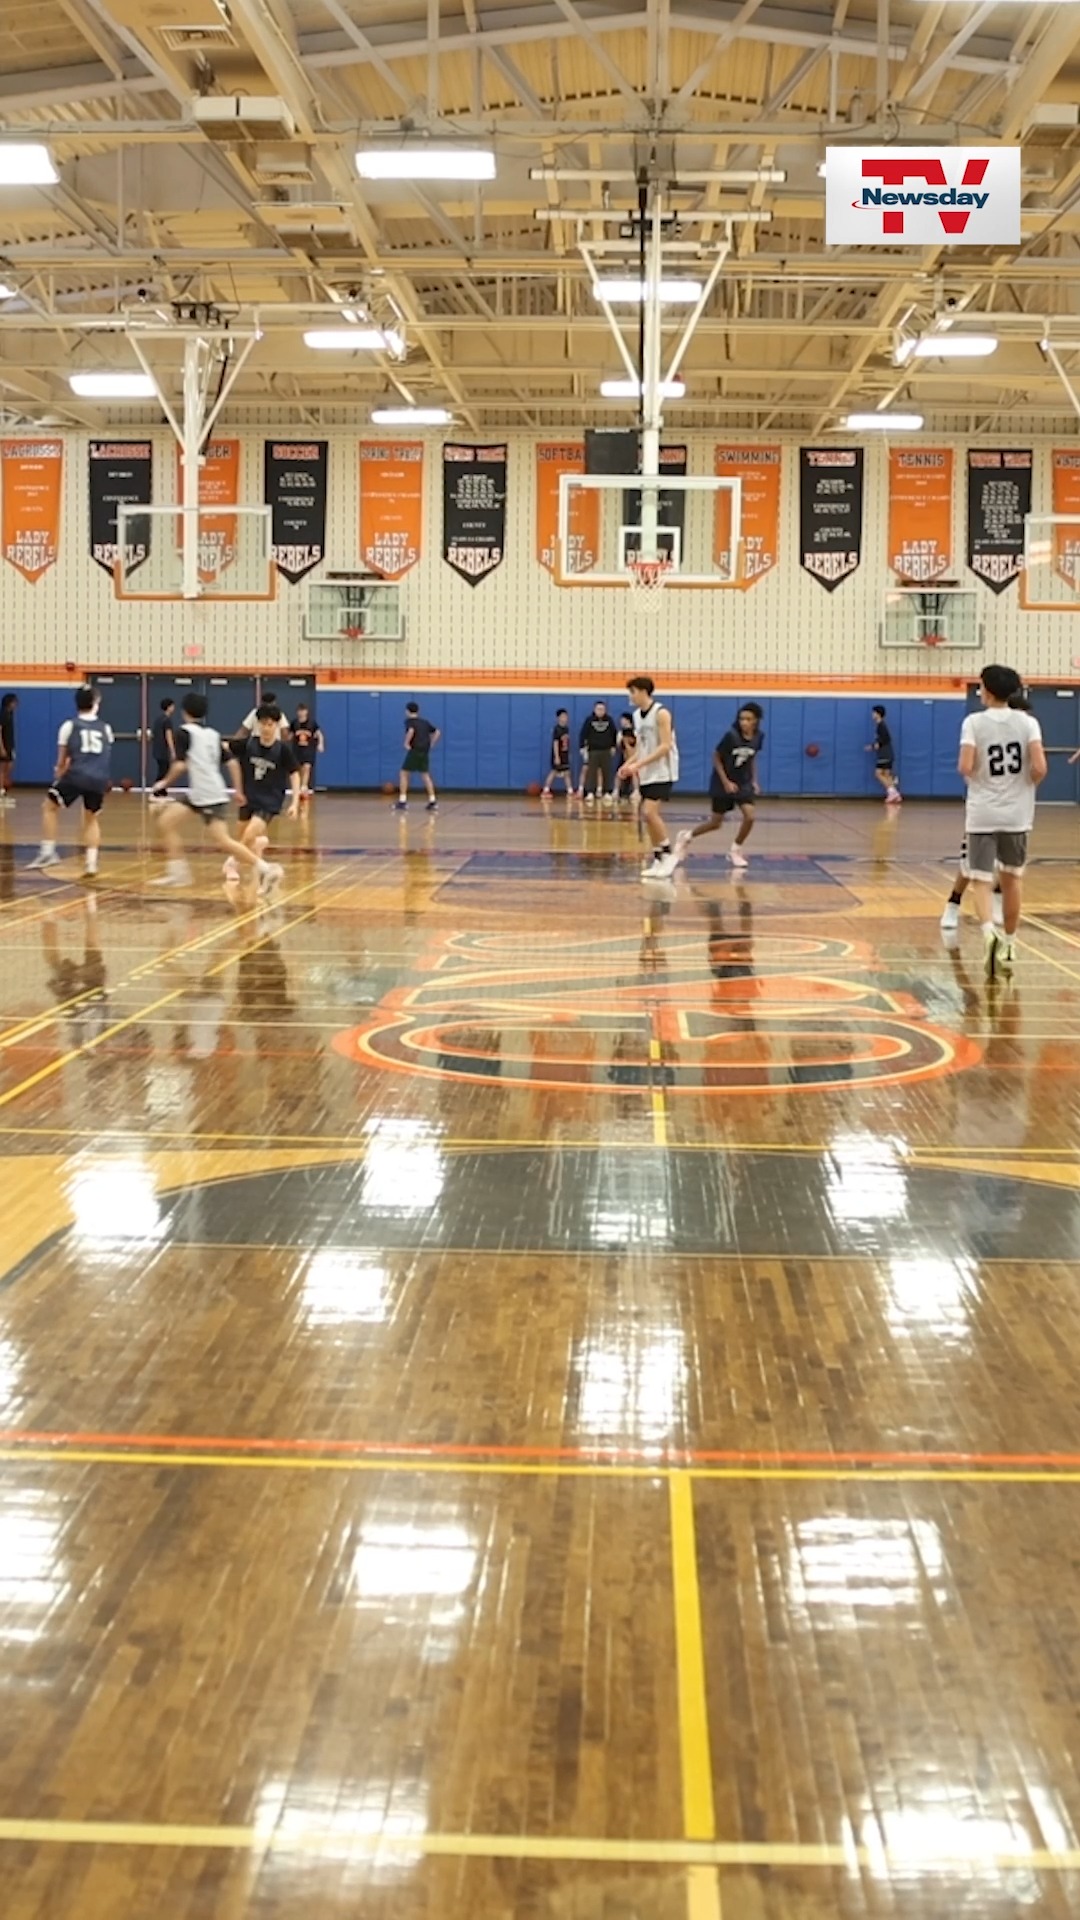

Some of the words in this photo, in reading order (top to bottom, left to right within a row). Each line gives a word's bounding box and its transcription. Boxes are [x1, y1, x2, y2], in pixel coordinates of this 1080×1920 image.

[91, 444, 150, 458] LACROSSE
[273, 445, 319, 460] SOCCER
[539, 447, 584, 462] SOFTBA
[807, 451, 856, 467] TENNIS
[898, 454, 944, 468] TENNIS
[16, 530, 49, 544] LADY
[200, 532, 226, 545] ADY
[374, 532, 408, 546] LADY
[902, 541, 937, 554] LADY
[6, 545, 55, 572] REBELS
[272, 545, 321, 573] REBELS
[366, 547, 416, 574] REBELS
[448, 547, 501, 576] REBELS
[720, 551, 772, 579] RELS
[804, 551, 858, 581] REBELS
[894, 555, 947, 581] REBELS
[972, 555, 1024, 583] REBELS
[80, 729, 102, 753] 15
[988, 742, 1021, 776] 23
